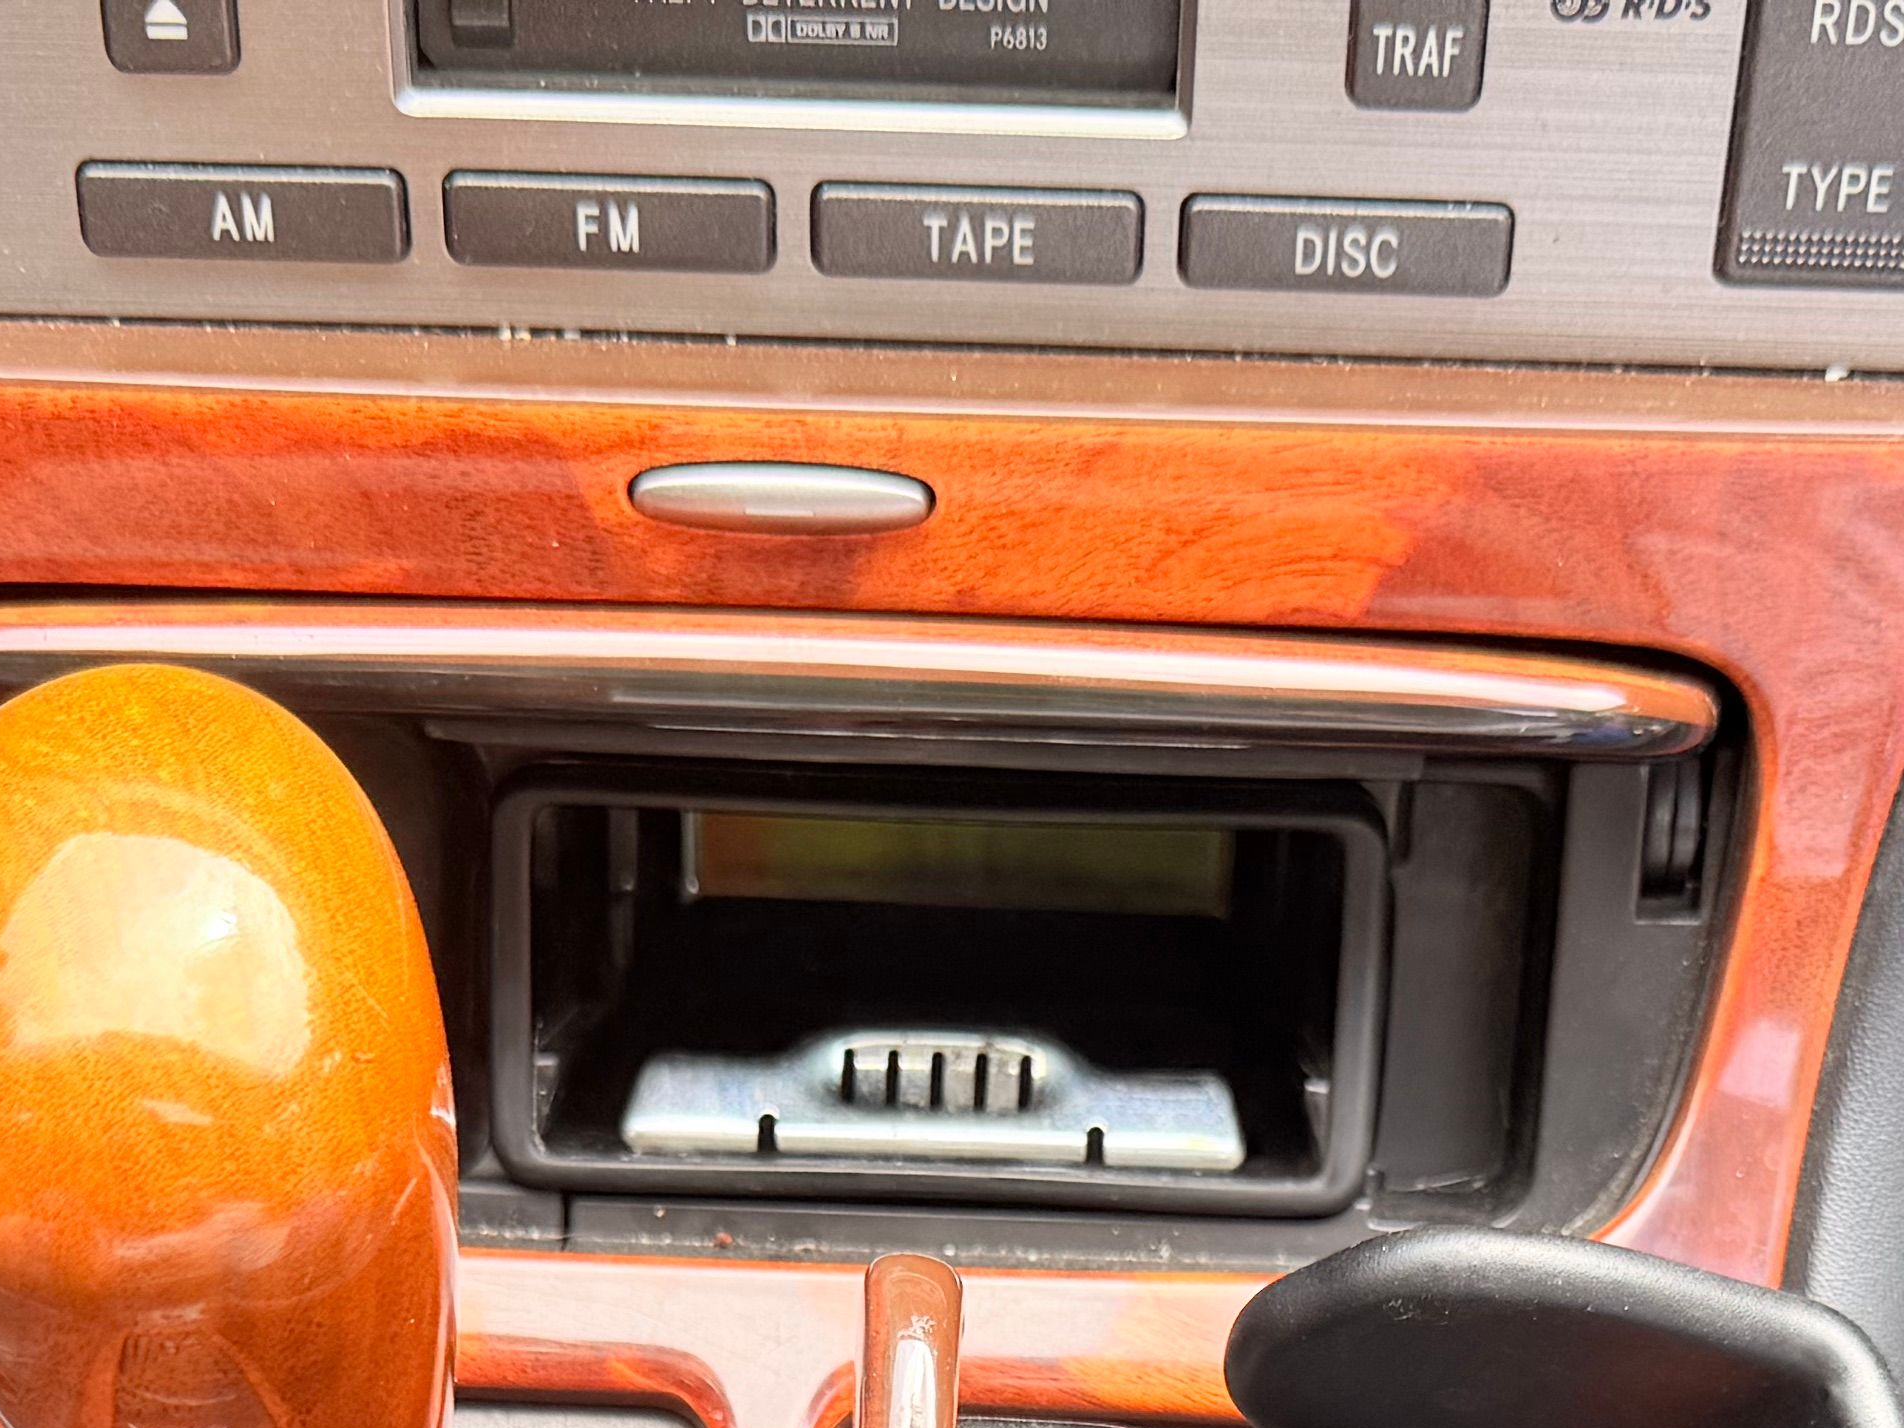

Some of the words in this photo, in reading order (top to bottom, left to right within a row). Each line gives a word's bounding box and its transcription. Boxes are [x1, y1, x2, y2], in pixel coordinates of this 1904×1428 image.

[796, 22, 846, 38] DOLBY
[989, 25, 1047, 50] P6813
[1372, 25, 1463, 77] TRAF
[1781, 164, 1892, 216] TYPE
[211, 192, 276, 245] AM
[576, 200, 641, 254] FM
[923, 218, 1035, 267] TAPE
[1295, 225, 1400, 279] DISC
